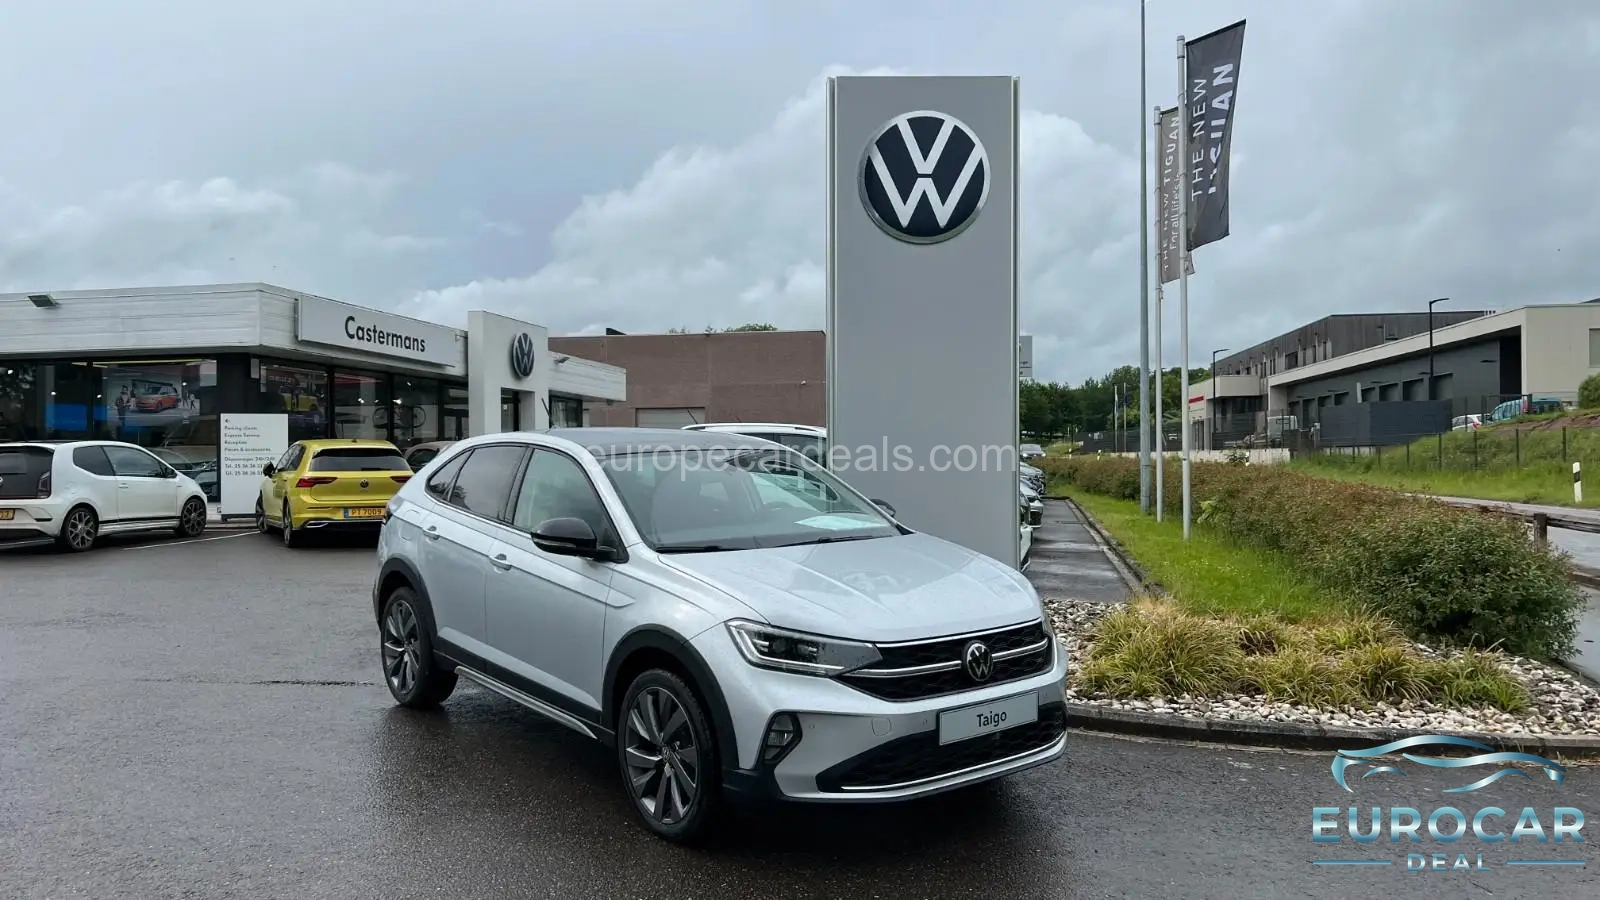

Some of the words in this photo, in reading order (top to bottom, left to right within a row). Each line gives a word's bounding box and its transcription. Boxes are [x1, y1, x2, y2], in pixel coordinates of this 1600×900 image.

[1192, 79, 1207, 138] NEW
[1163, 116, 1180, 187] TIGUAN
[1191, 149, 1204, 202] THE
[1170, 214, 1179, 228] all
[344, 315, 426, 353] Castermans
[976, 711, 1007, 727] Taigo
